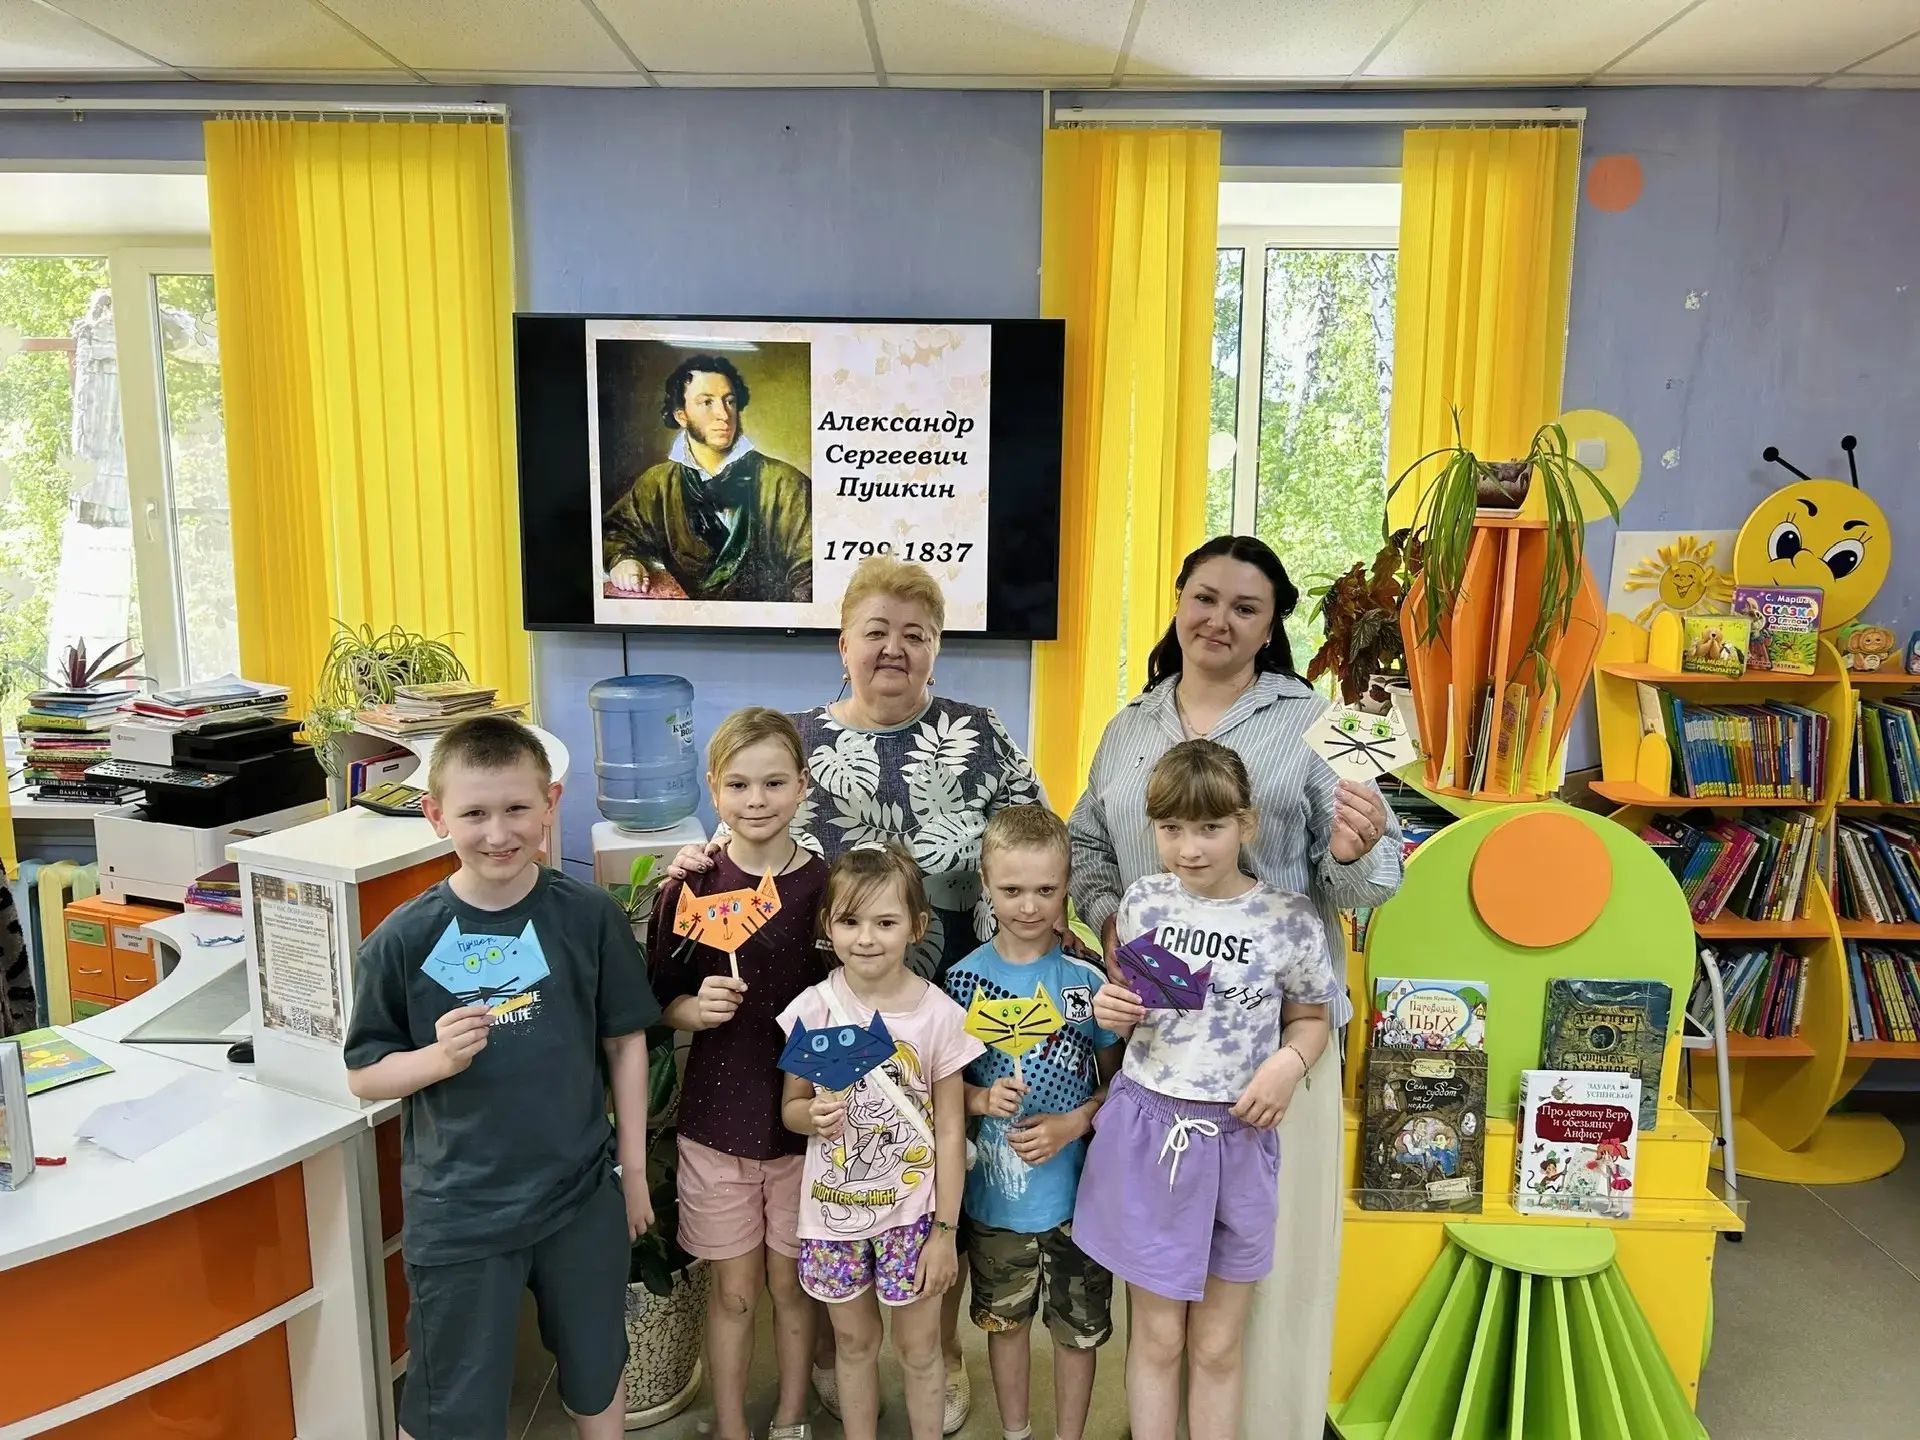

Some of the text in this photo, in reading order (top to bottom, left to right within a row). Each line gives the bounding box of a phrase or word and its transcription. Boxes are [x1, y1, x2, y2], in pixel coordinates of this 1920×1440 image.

[818, 411, 974, 439] Александр
[826, 444, 968, 469] Сергеевич
[837, 477, 955, 502] Пушкин
[1764, 604, 1815, 618] СКАЗКА
[1161, 927, 1252, 964] CHOOSE
[1409, 1014, 1458, 1033] ПЫХ
[1586, 1091, 1634, 1099] УСПЕНСКИЙ
[1541, 1105, 1629, 1122] Про девочку Веру
[1562, 1117, 1614, 1132] обезьянку
[1564, 1128, 1604, 1142] Анфису
[867, 1187, 898, 1208] HIGH
